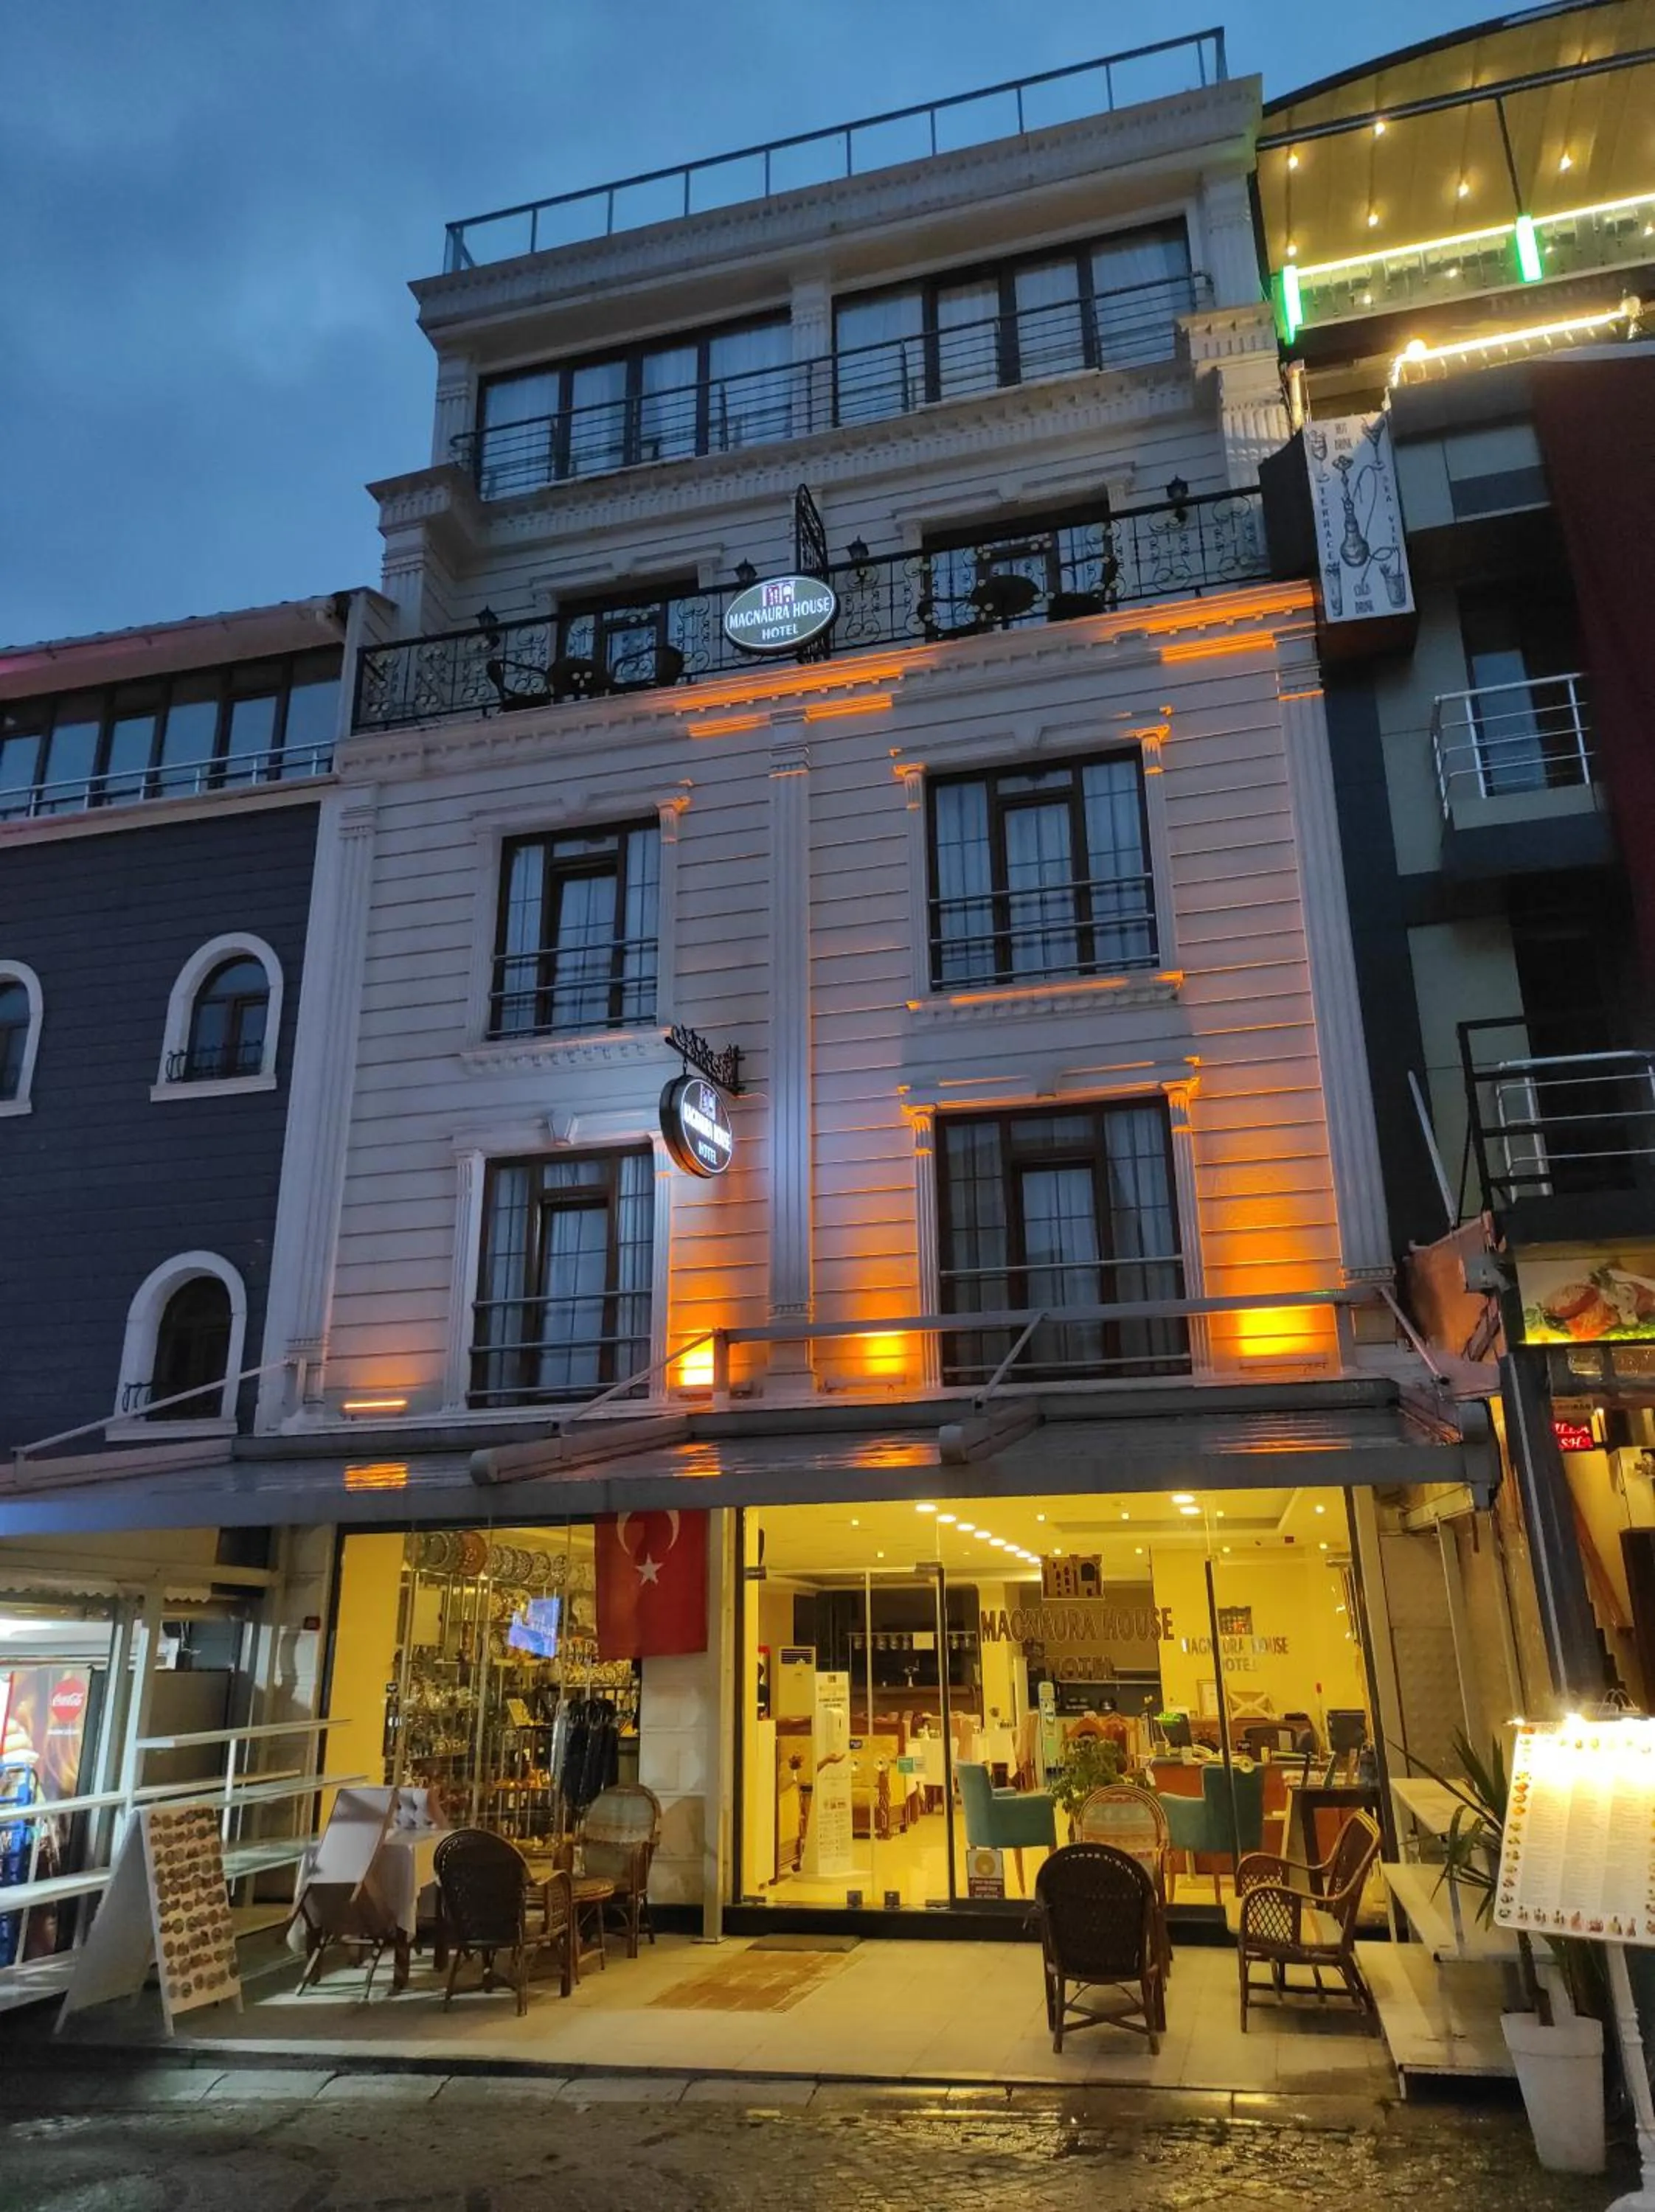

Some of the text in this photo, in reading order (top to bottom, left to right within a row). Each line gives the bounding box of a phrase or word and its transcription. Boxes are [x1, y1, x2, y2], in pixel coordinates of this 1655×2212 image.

[729, 597, 830, 630] MAGNAURA HOUSE
[762, 624, 798, 640] HOTEL
[698, 1141, 717, 1165] HOTEL
[980, 1606, 1175, 1643] MAGNAURA HOUSE
[1044, 1655, 1116, 1680] HOTEL
